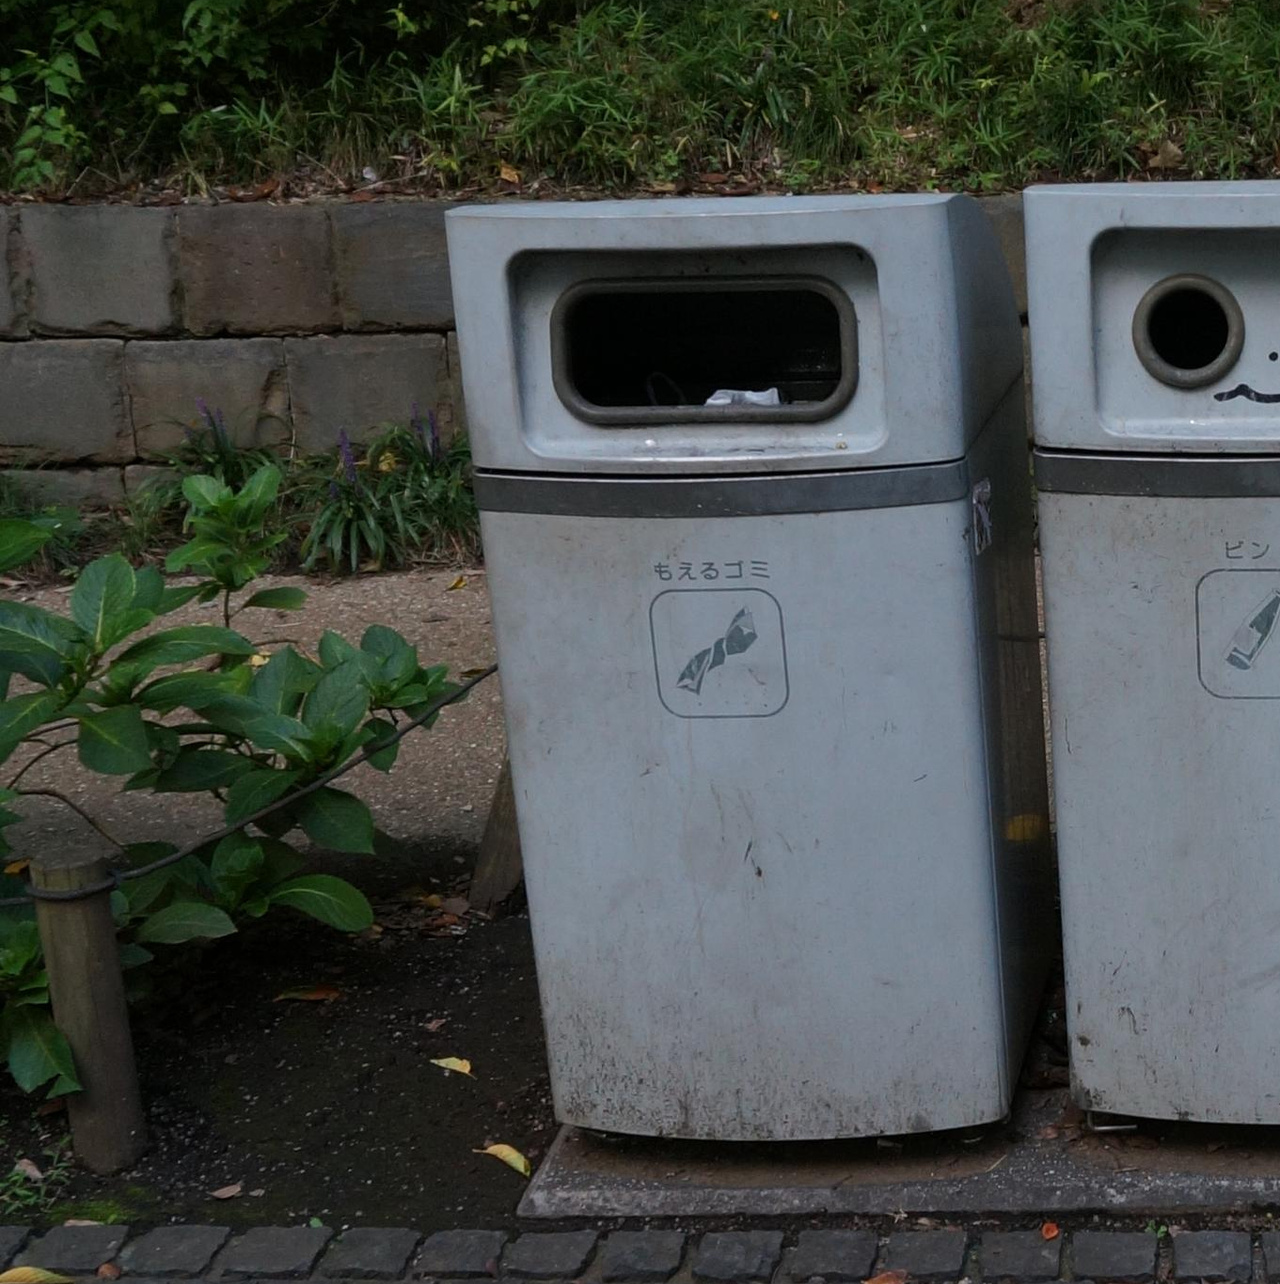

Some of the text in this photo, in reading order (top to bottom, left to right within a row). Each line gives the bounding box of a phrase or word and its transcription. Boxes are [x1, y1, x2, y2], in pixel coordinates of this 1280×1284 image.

[654, 559, 770, 581] もえるゴミ
